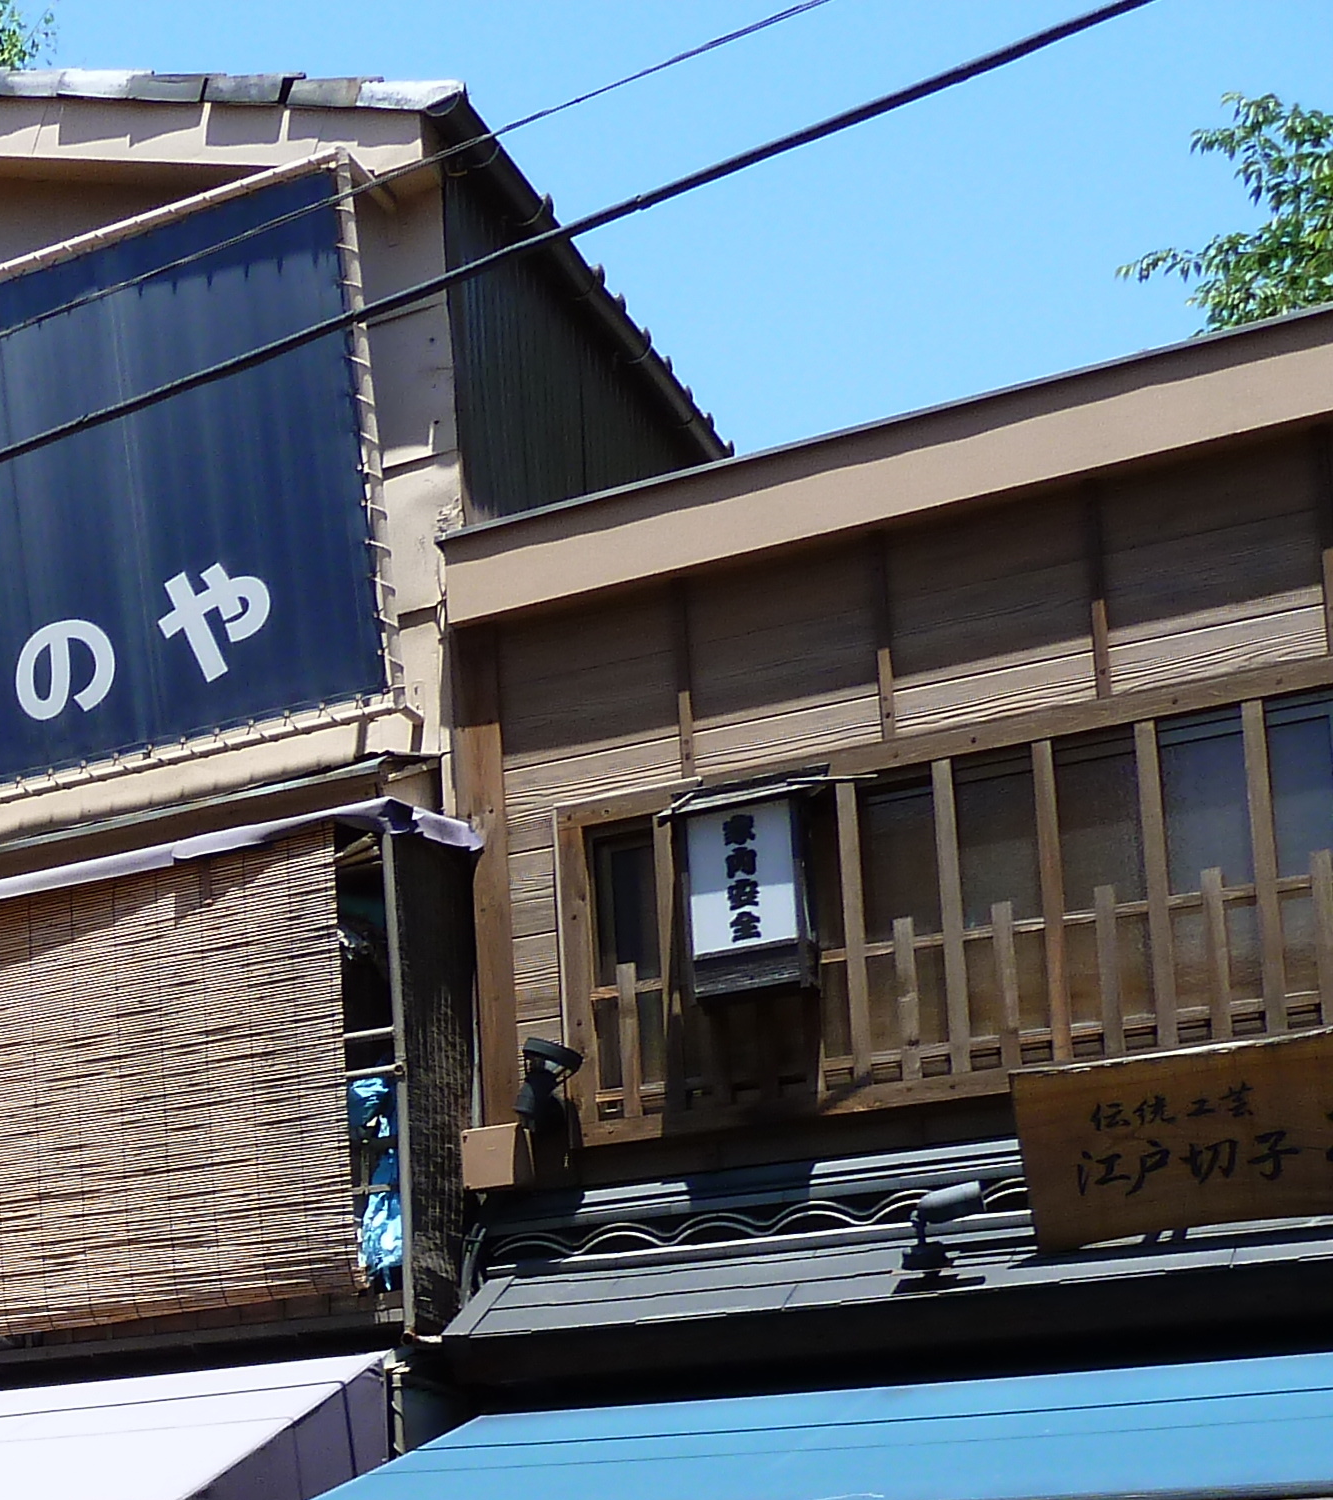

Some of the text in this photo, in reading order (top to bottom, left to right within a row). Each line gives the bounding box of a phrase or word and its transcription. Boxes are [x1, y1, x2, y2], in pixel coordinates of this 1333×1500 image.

[722, 814, 762, 943] 家内安全
[1089, 1081, 1254, 1131] 伝統工芸
[1076, 1129, 1301, 1197] 江戸切子
